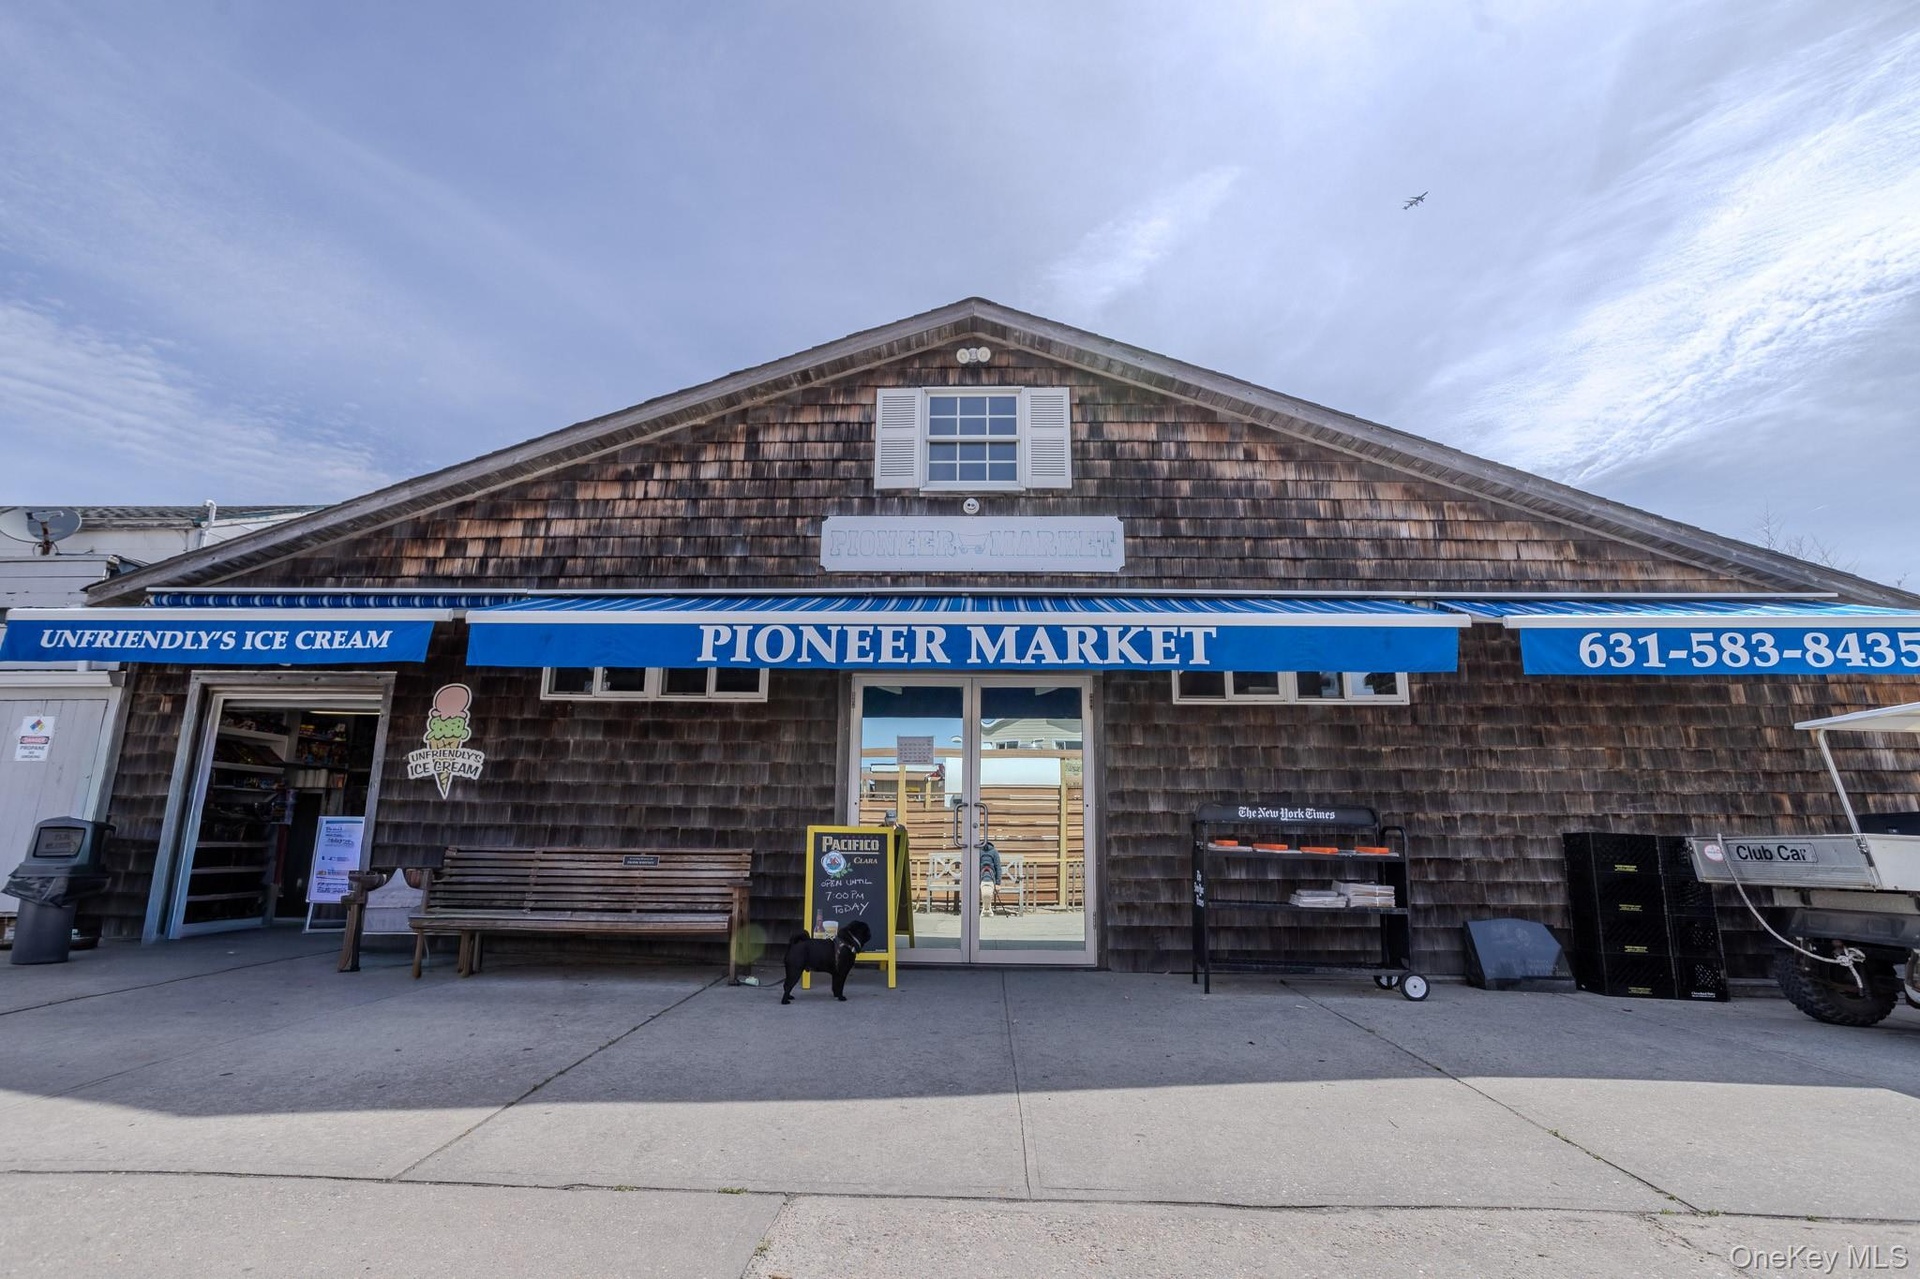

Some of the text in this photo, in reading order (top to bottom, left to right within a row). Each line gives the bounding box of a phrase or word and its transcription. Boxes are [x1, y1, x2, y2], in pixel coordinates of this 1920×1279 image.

[830, 530, 1116, 558] PIONEER MARKET
[40, 629, 393, 651] UNFRIENDLY'S ICE CREAM
[696, 624, 1217, 666] PIONEER MARKET
[1579, 632, 1920, 668] 631-583-8435
[411, 749, 482, 763] UNFRIENDLY'S
[410, 761, 479, 777] ICE CREAM
[1238, 806, 1336, 821] The New York Times
[821, 835, 880, 853] PACIFICO
[853, 856, 878, 864] CLARA
[1736, 845, 1774, 860] Club
[1777, 845, 1806, 860] Car
[846, 878, 873, 886] UNTIL
[825, 889, 865, 901] 7:00 PM
